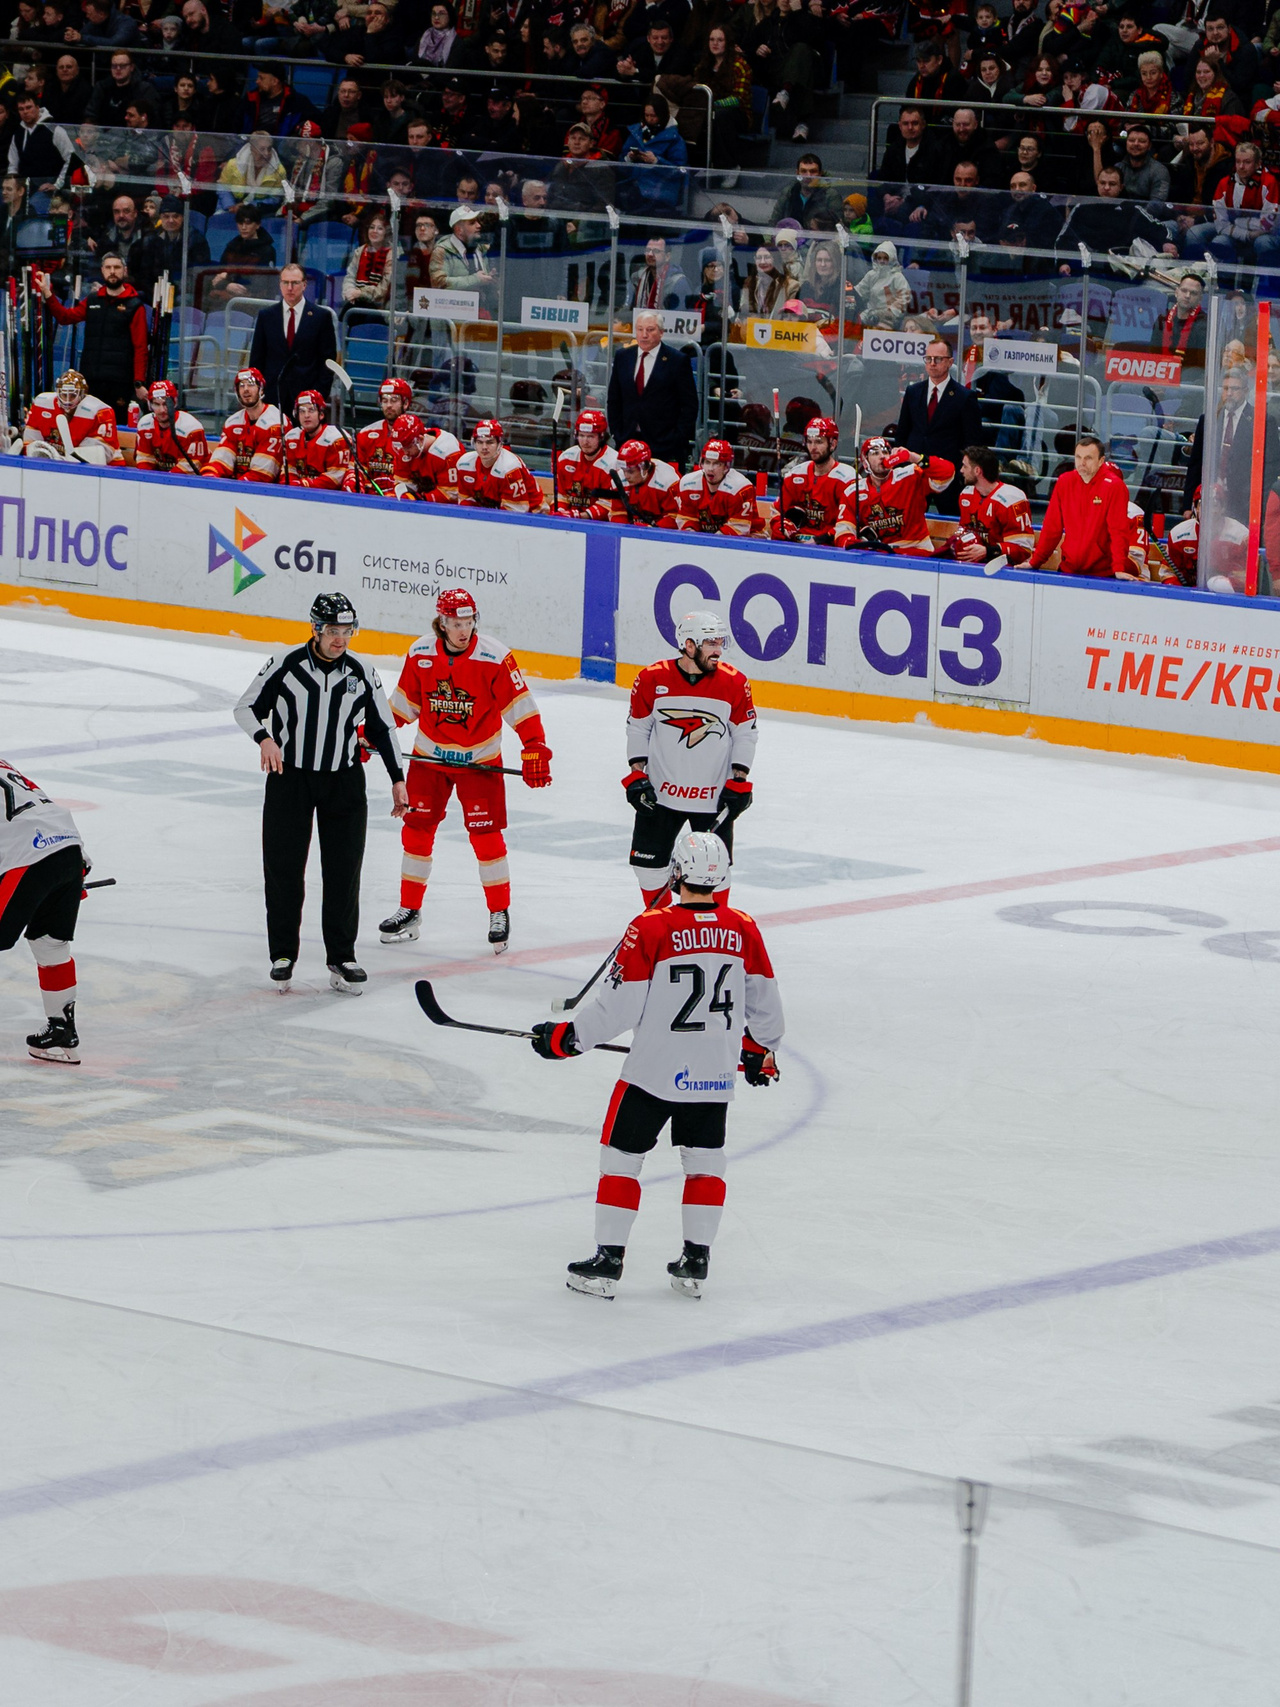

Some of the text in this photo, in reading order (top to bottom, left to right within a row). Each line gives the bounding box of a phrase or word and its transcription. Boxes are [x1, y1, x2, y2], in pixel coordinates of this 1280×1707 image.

[530, 305, 580, 323] SIBUR
[774, 331, 809, 342] БАНК
[1003, 350, 1054, 364] ГАЗПРОМБАНК
[1106, 357, 1180, 380] FONBET
[97, 423, 113, 438] 45
[186, 441, 204, 457] 40
[509, 478, 527, 498] 25
[986, 502, 993, 517] A
[1015, 513, 1032, 531] 74
[362, 552, 508, 586] система быстрых
[362, 574, 441, 598] платежей
[1087, 627, 1106, 639] МЫ
[1112, 630, 1158, 645] ВСЕГДА
[1165, 636, 1179, 648] НА
[1186, 638, 1227, 653] СВЯЗИ
[1085, 646, 1280, 713] T.ME/KR
[429, 698, 475, 717] REDSTAR
[433, 745, 473, 762] SIBUR
[660, 781, 718, 800] FONBET
[469, 820, 494, 828] CCM
[671, 927, 743, 952] SOLOVYEV
[669, 962, 735, 1032] 24
